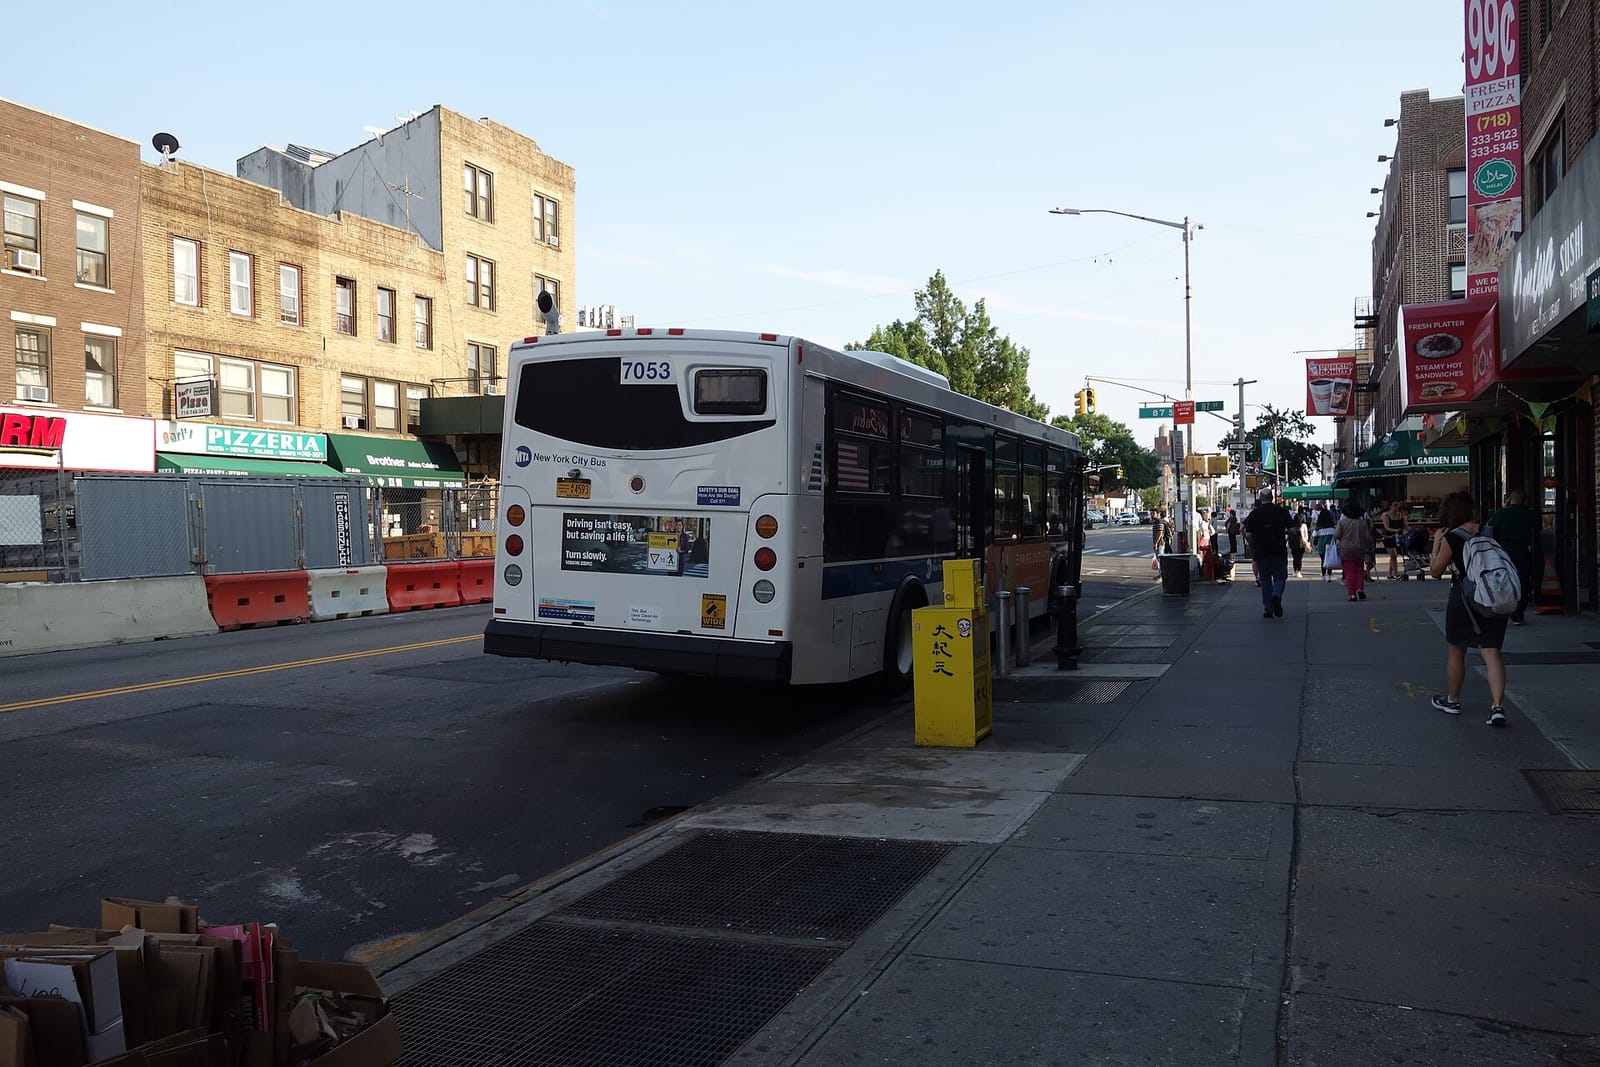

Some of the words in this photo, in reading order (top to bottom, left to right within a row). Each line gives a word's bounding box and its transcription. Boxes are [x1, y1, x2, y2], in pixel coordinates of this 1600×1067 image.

[1471, 79, 1515, 98] FRESH
[1473, 93, 1515, 112] PIZZA
[1477, 111, 1511, 132] (718)
[1471, 128, 1518, 146] 333-5123
[1470, 140, 1519, 158] 333-5345
[1559, 220, 1584, 278] SUSHI
[1475, 278, 1489, 286] WE
[1408, 323, 1433, 331] FRESH
[1433, 320, 1465, 329] PLATTER
[622, 361, 671, 380] 7053
[1415, 363, 1444, 372] STEAMY
[1415, 370, 1464, 379] SANDWICHES
[180, 396, 209, 409] Pizza
[1152, 409, 1165, 417] 87
[0, 413, 67, 448] RM
[208, 428, 320, 453] PIZZERIA
[366, 454, 405, 467] Brother
[533, 453, 550, 462] New
[552, 454, 569, 464] York
[571, 455, 588, 467] City
[590, 457, 607, 467] Bus
[1417, 456, 1450, 465] GARDEN
[1452, 455, 1469, 464] HILL
[566, 519, 593, 531] Driving
[594, 520, 612, 530] isn't
[566, 530, 579, 540] but
[580, 531, 605, 542] saving
[612, 532, 625, 542] life
[627, 533, 637, 542] is.
[565, 550, 582, 560] Turn
[582, 551, 607, 562] slowly.
[703, 617, 724, 625] WIDE
[932, 624, 954, 677] 大紀元
